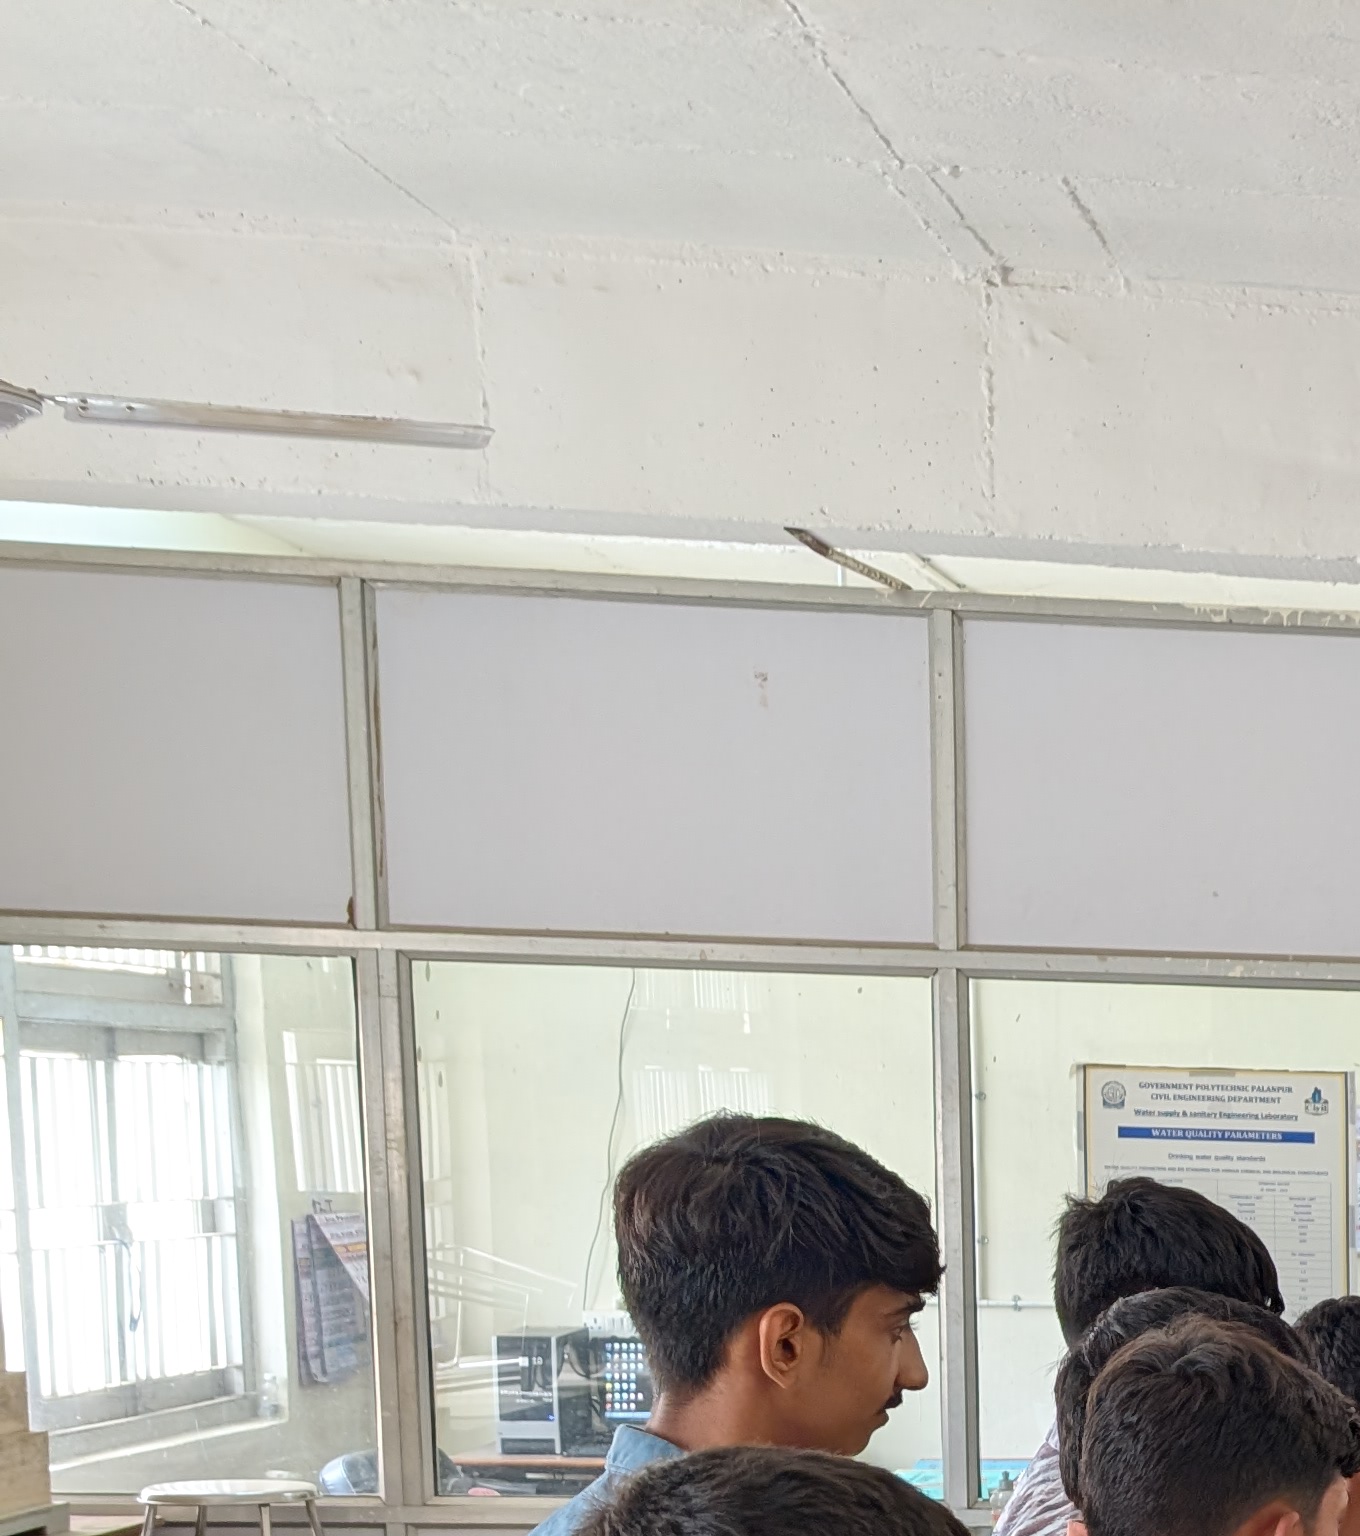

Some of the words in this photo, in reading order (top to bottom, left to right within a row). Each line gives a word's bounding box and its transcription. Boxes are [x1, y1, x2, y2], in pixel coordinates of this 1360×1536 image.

[1139, 1082, 1193, 1091] GOVERNMENT
[1195, 1083, 1249, 1092] POLYTECHNIC
[1251, 1084, 1293, 1094] PALANPUR
[1151, 1093, 1171, 1101] CIVIL
[1173, 1094, 1226, 1103] ENGINEERING
[1228, 1095, 1281, 1104] DEPARTMENT
[1151, 1128, 1184, 1138] WATER
[1185, 1130, 1223, 1140] QUALITY
[1225, 1131, 1283, 1140] PARAMETERS
